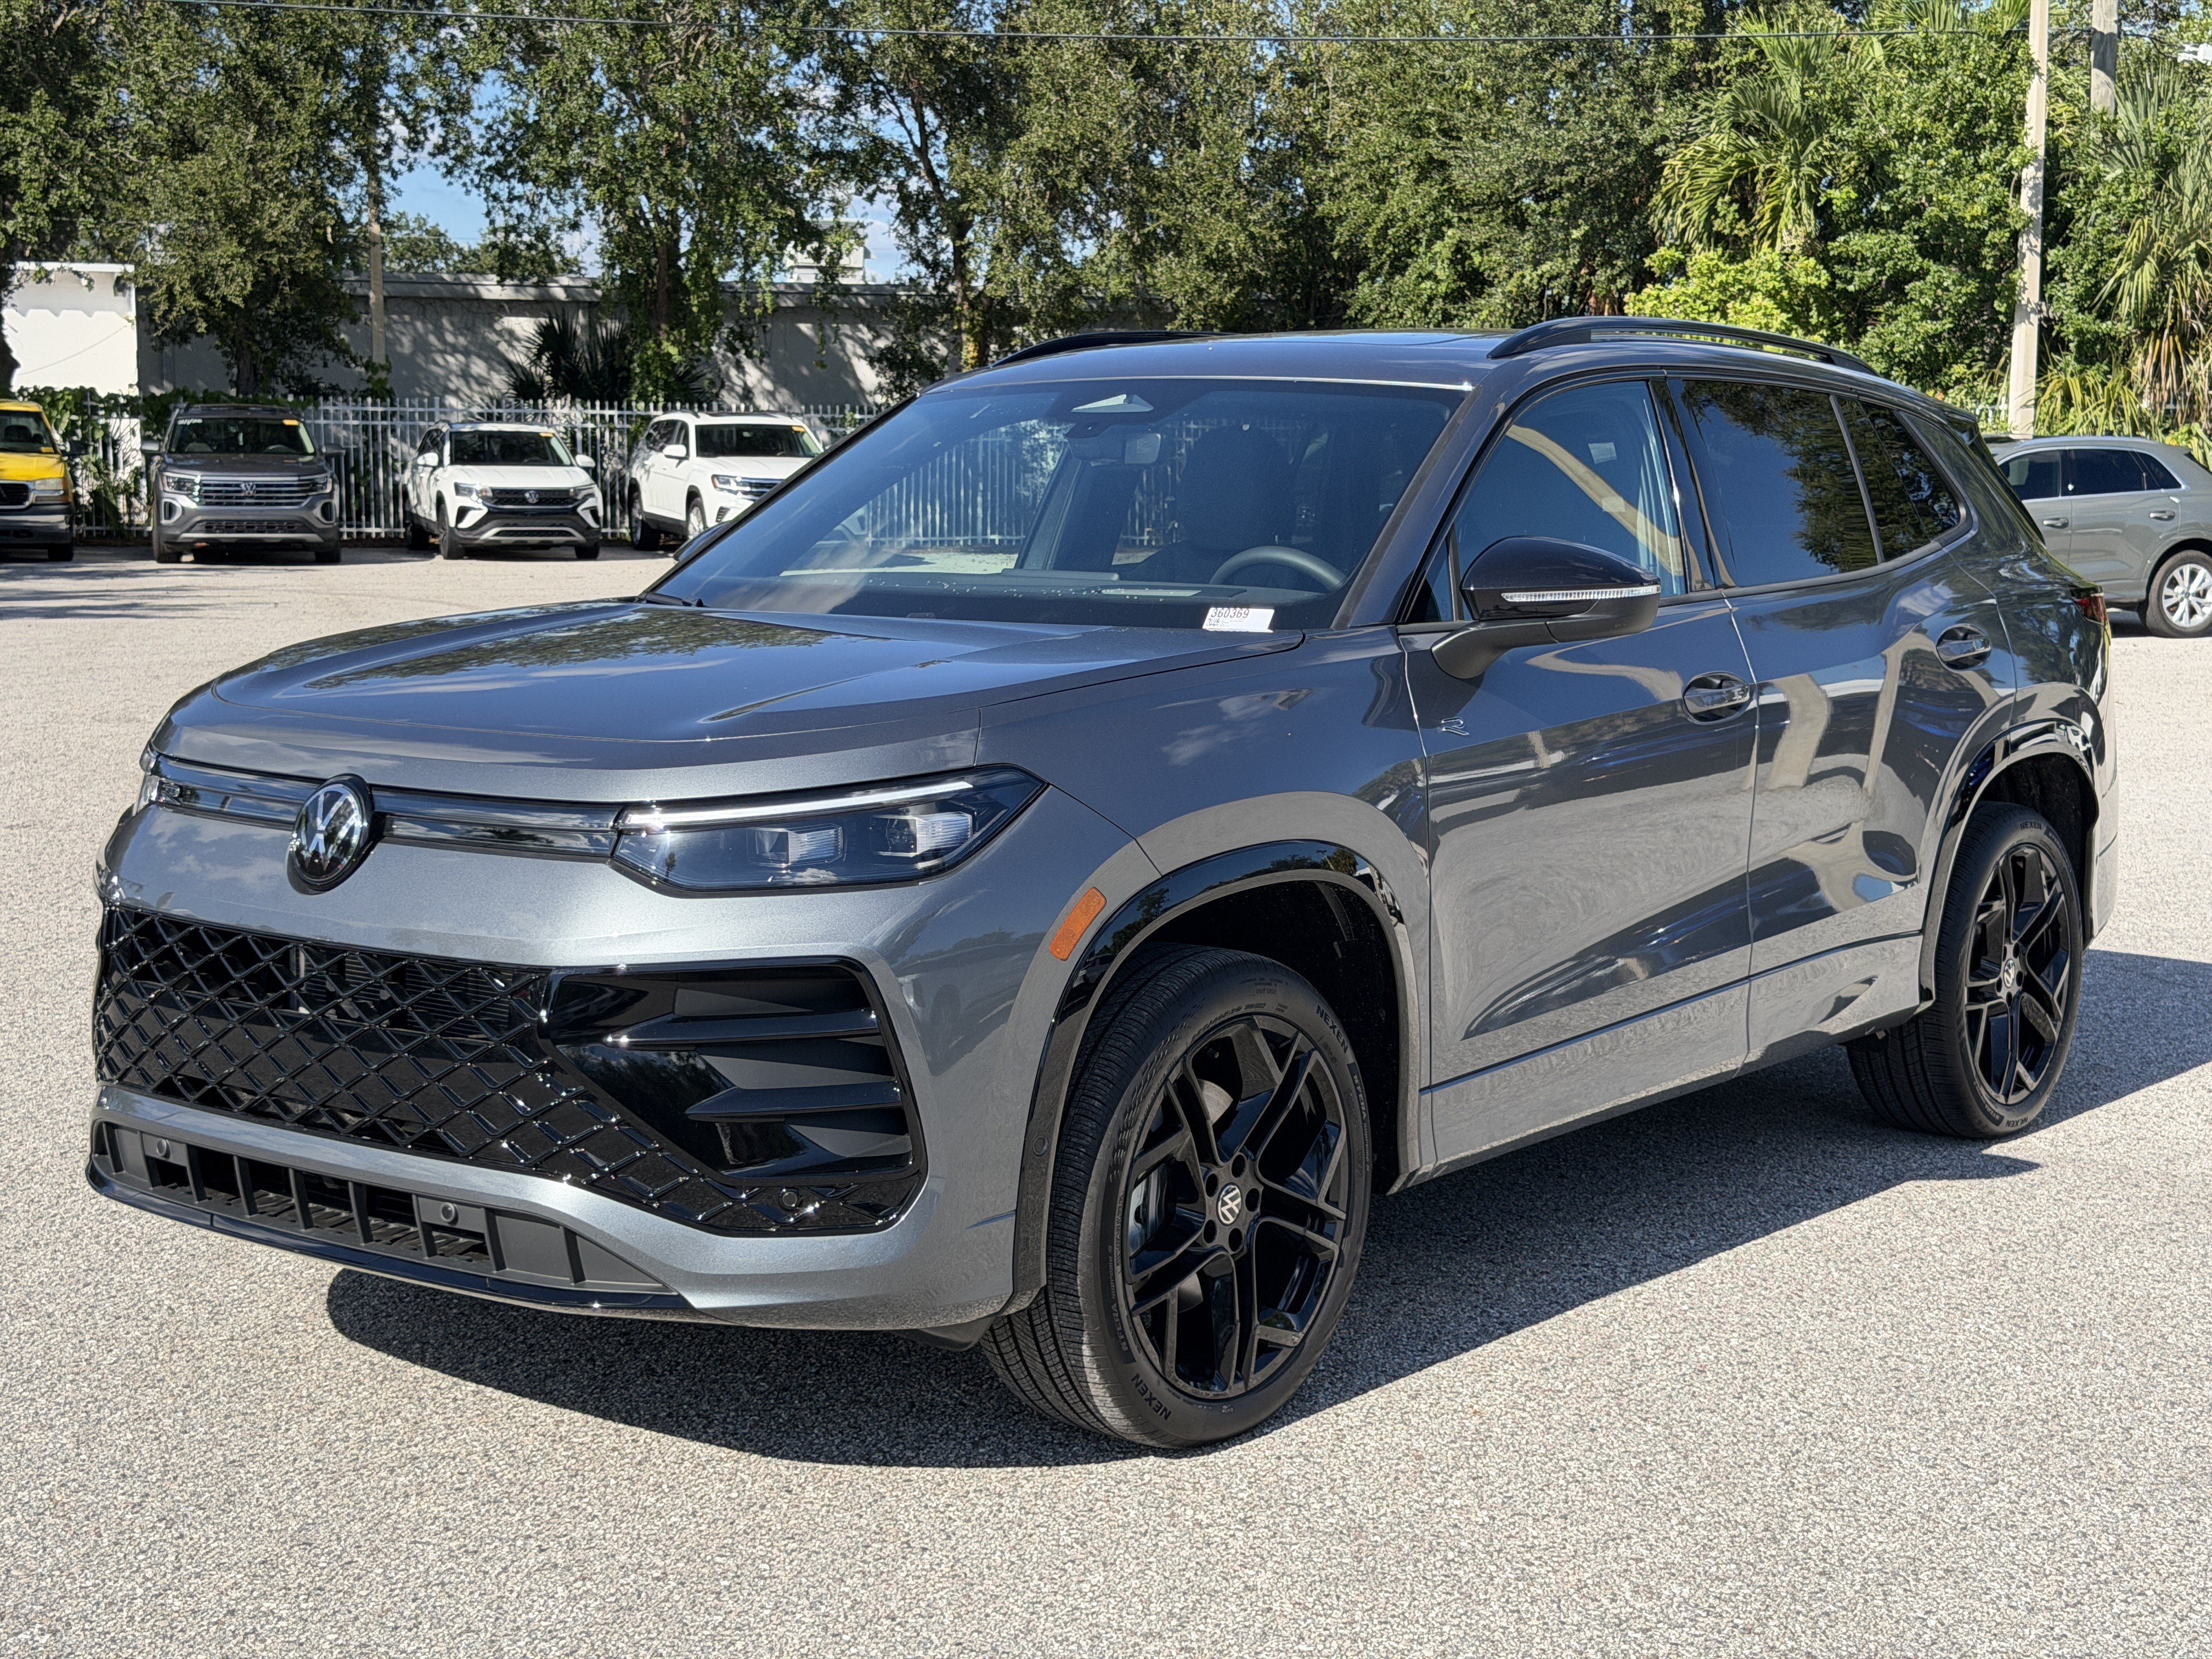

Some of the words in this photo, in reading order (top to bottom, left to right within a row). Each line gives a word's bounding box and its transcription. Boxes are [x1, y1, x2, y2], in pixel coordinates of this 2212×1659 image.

[1211, 608, 1250, 619] 360369
[300, 783, 362, 879] VW
[2020, 821, 2042, 831] NEXEN
[1316, 1004, 1348, 1054] NEXEN
[2005, 1116, 2029, 1128] NEXEN
[1218, 1184, 1242, 1224] VW
[1131, 1373, 1172, 1421] NEXEN
